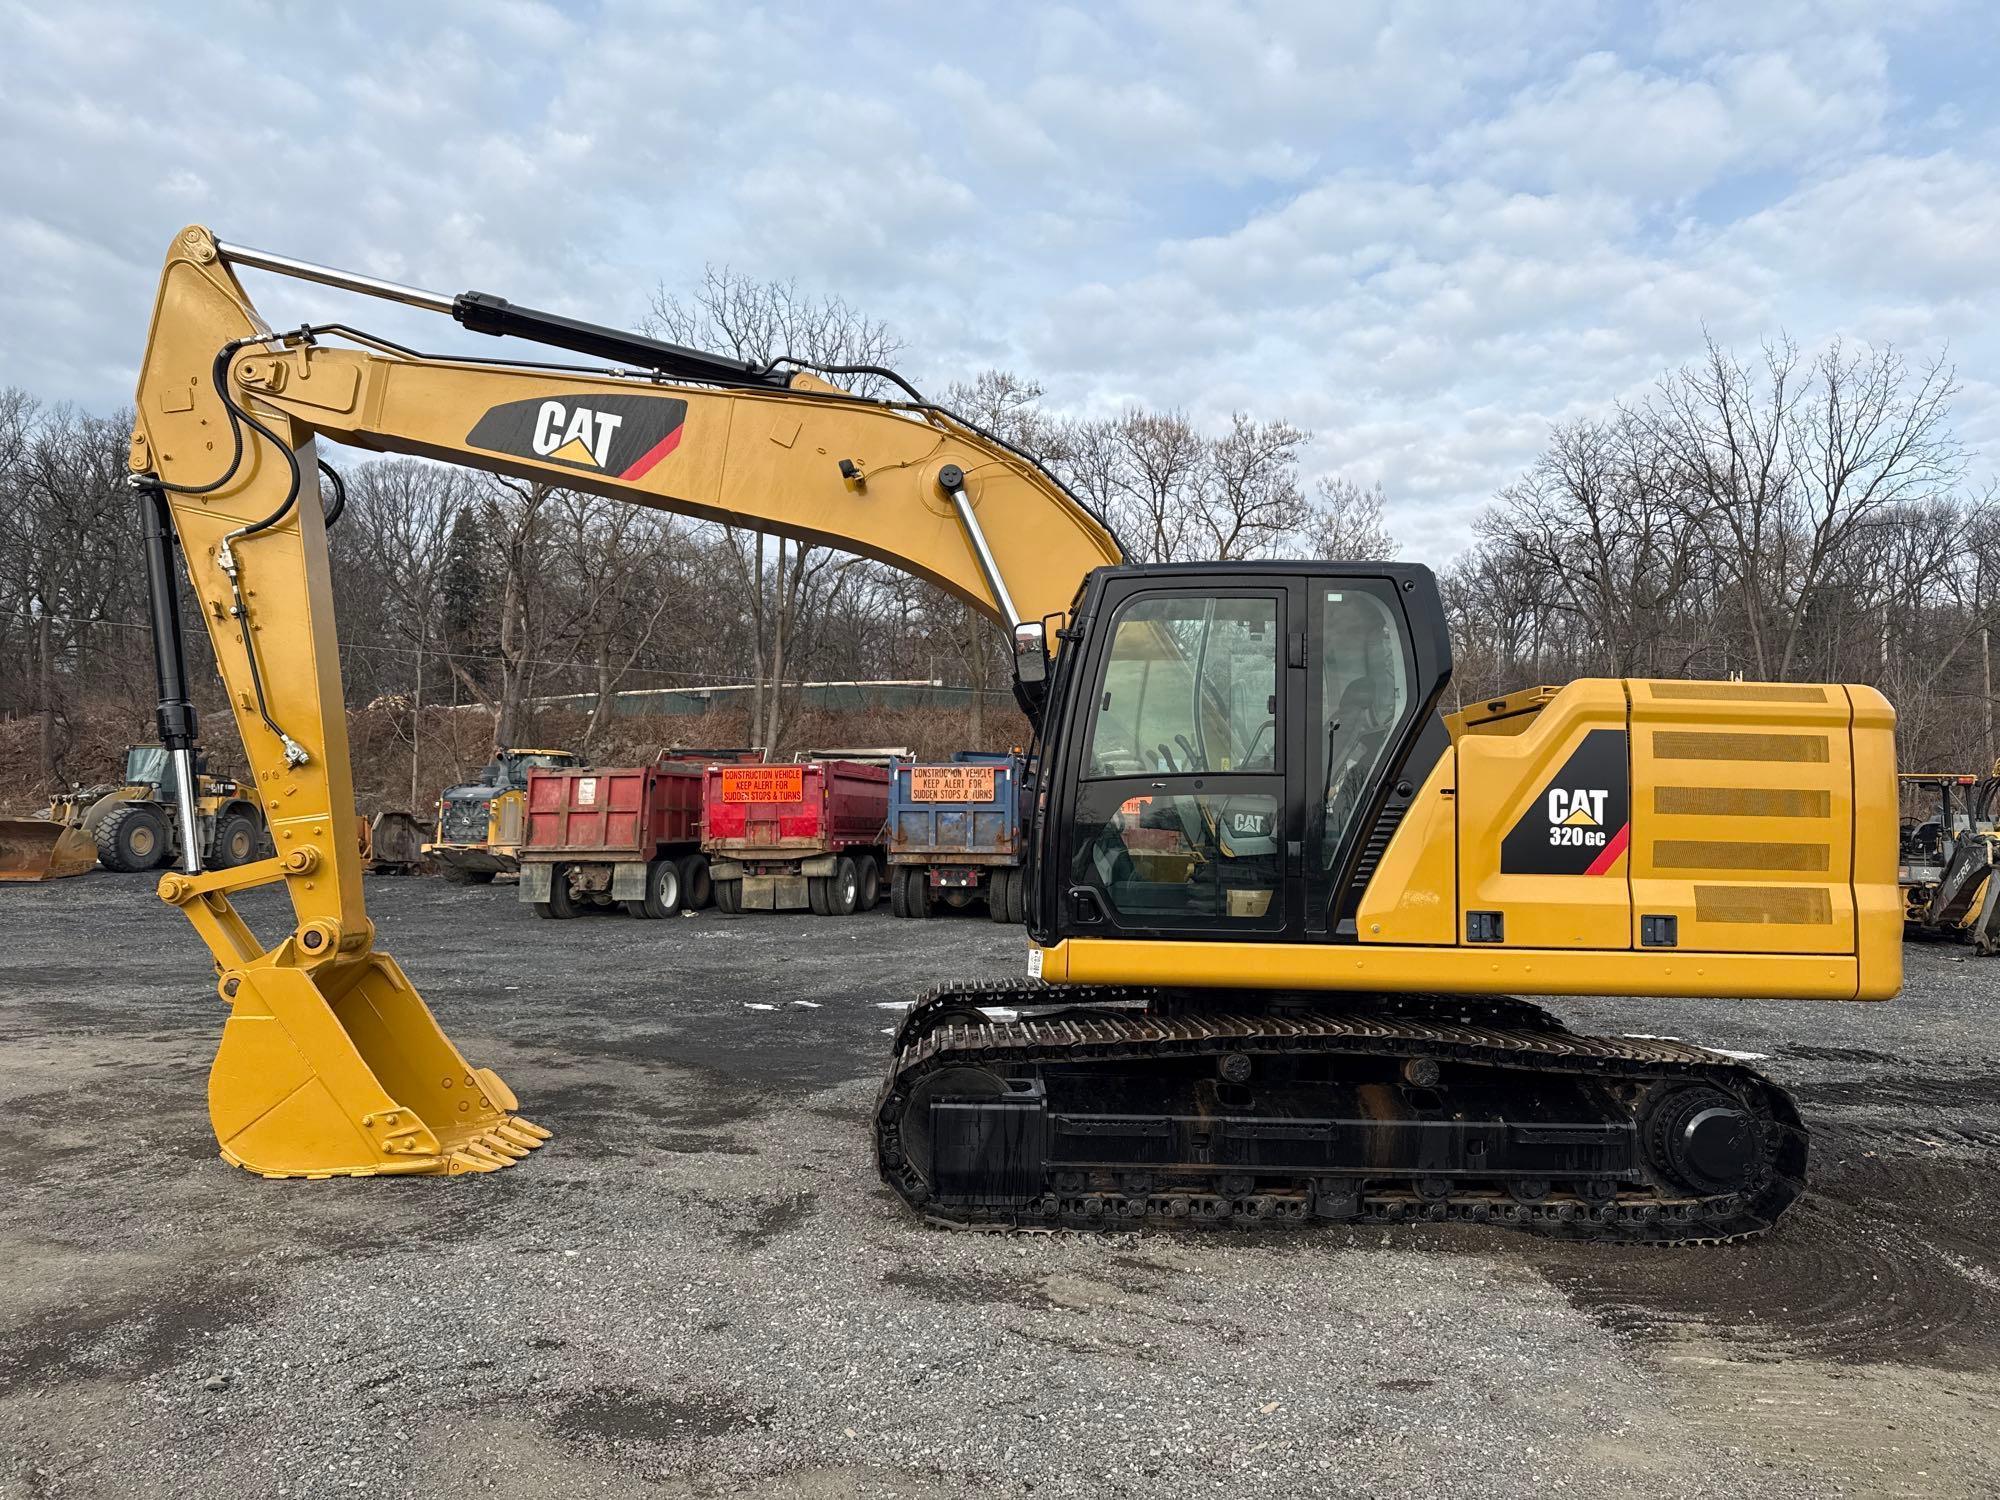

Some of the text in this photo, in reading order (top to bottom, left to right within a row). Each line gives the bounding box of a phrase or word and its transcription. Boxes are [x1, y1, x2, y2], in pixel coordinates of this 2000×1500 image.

[532, 400, 622, 468] CAT
[725, 769, 800, 779] CONSTRUCTION VEHICLE
[914, 768, 961, 777] CONSTRUCON
[736, 781, 788, 790] KEEP ALERT FOR
[923, 779, 981, 788] KEEP ALERT FOR
[724, 791, 800, 800] SUDDEN STOPS & TURNS
[913, 790, 938, 799] SUDDEN
[940, 790, 961, 799] STOPS
[963, 790, 969, 799] &
[1548, 788, 1609, 826] CAT
[1234, 813, 1264, 833] CAT
